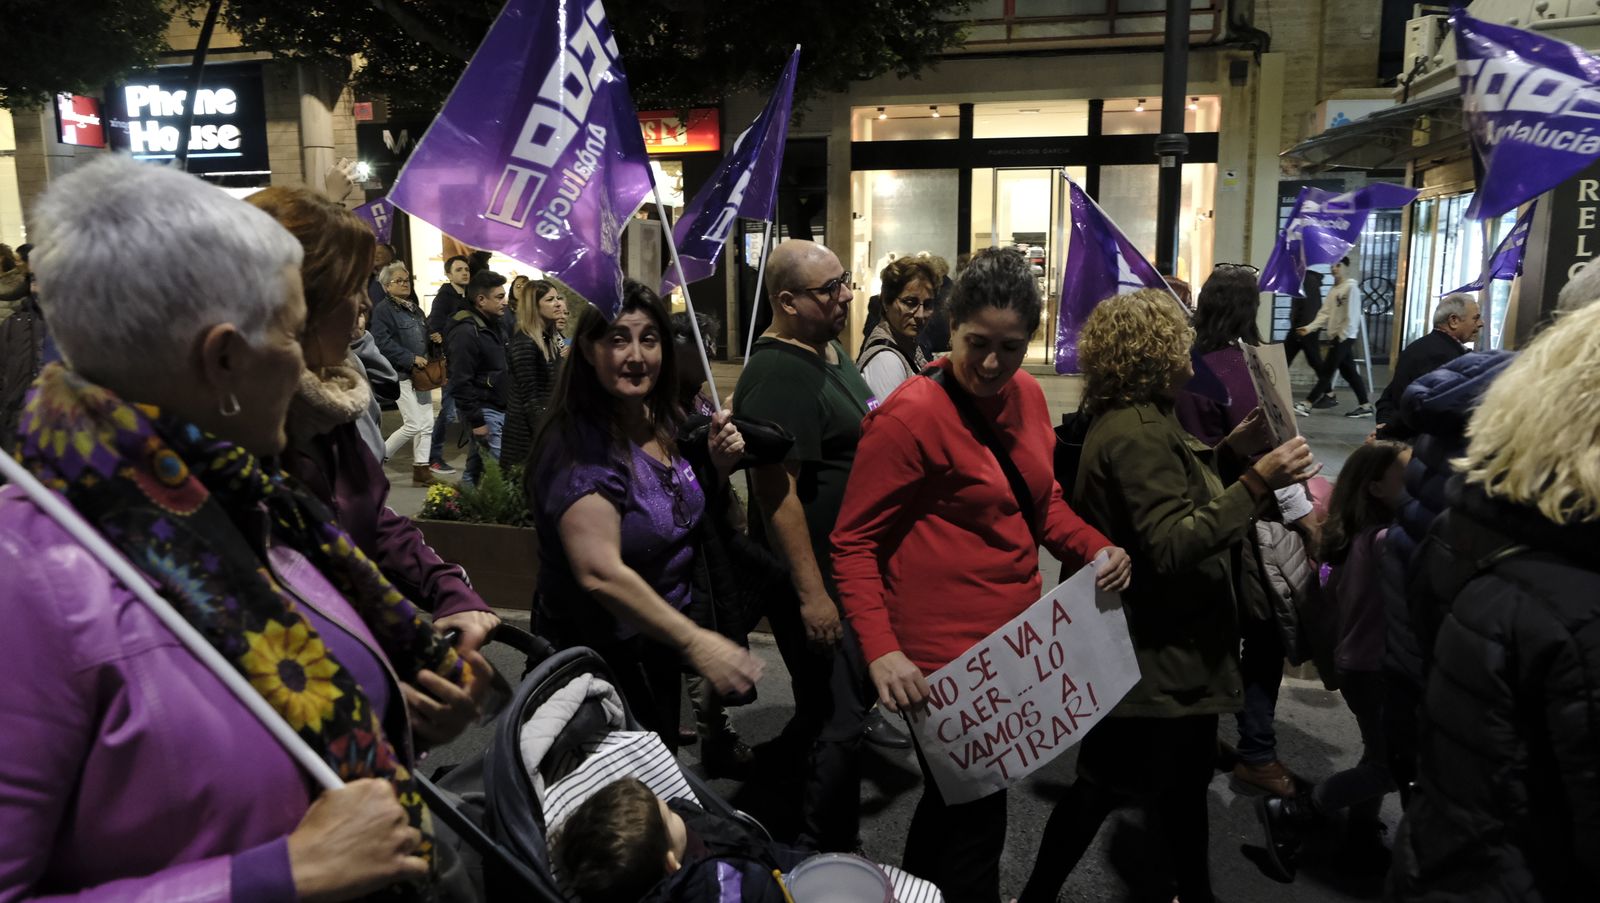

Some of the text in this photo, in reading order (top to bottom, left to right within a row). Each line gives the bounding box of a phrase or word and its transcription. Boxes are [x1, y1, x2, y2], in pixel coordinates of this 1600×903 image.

[966, 647, 998, 692] SE
[1002, 620, 1043, 659] VA
[1052, 599, 1072, 637] A
[1033, 641, 1065, 683] LO
[948, 673, 1078, 771] VAMOS A
[985, 681, 1101, 781] TIRAR!
